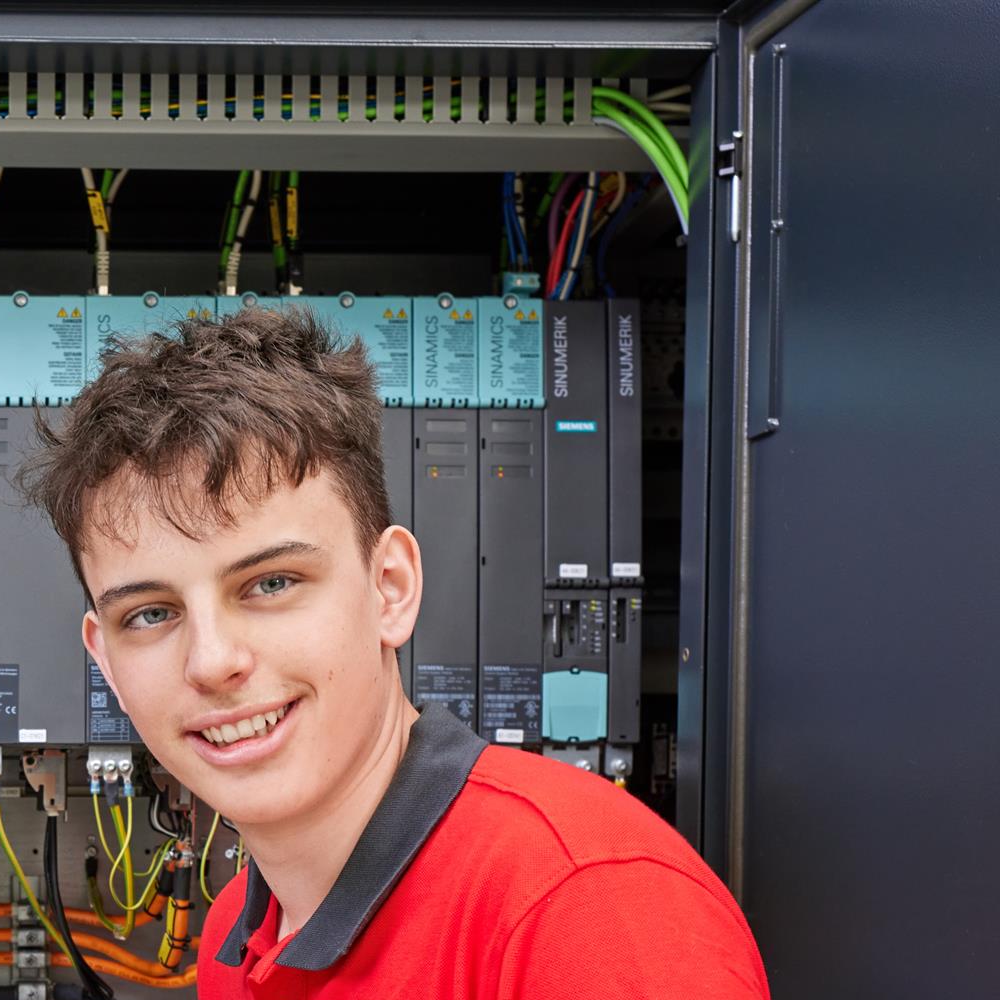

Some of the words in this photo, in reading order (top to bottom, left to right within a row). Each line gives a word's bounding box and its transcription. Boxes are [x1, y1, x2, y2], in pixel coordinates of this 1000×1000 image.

[425, 315, 439, 388] SINAMICS
[490, 316, 504, 388] SINAMICS
[553, 316, 568, 397] SINUMERIK
[619, 314, 634, 397] SINUMERIK
[558, 421, 595, 430] SIEMENS
